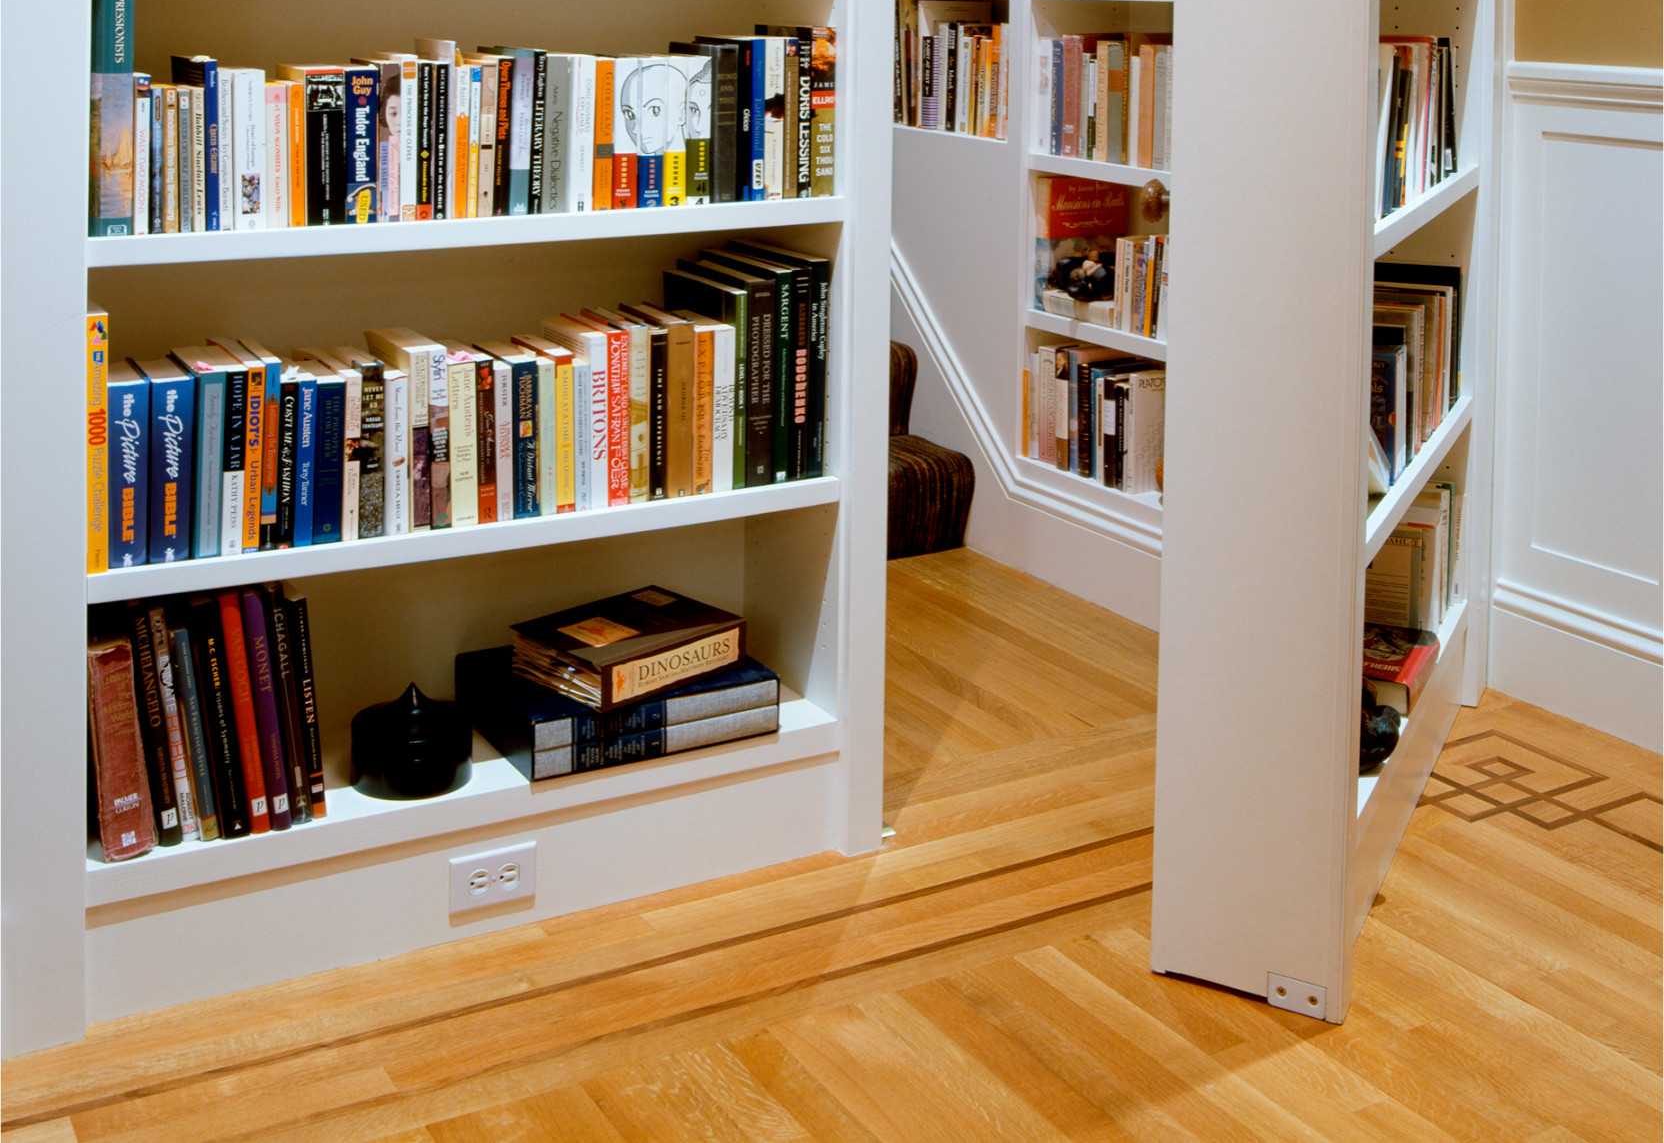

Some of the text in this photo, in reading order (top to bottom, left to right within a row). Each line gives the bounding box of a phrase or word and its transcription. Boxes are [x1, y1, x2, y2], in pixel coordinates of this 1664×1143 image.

[352, 76, 373, 85] John
[353, 86, 371, 96] Guy
[460, 71, 468, 86] Paul
[498, 62, 511, 139] Opera Themes Plots
[604, 72, 613, 137] GEORGIANA
[209, 124, 218, 145] Queen
[353, 106, 370, 181] Tudor England
[532, 100, 544, 196] LITERARY THEORY
[550, 112, 563, 209] Negative Dialectics
[799, 77, 810, 182] DORIS LESSING
[359, 196, 368, 221] USED
[819, 282, 827, 299] John
[463, 368, 473, 391] Jane
[751, 317, 760, 404] PHOTOGRAPHER
[762, 314, 771, 404] DRESSED FOR THE
[818, 336, 826, 360] Copley
[230, 375, 243, 468] HOPE IN JAR
[249, 395, 259, 446] IDIOT'S
[302, 388, 313, 447] Jane Austen
[452, 371, 460, 410] Letters
[592, 371, 606, 460] BRITONS
[610, 337, 620, 489] JONATHAN SAFRAN FOER
[89, 362, 106, 532] Amazing 1000 Puzzle Challenge
[115, 394, 140, 542] the Picture BIBLE
[159, 389, 183, 536] the Picture BIBLE
[281, 396, 295, 504] COSTUME FASHION
[230, 475, 238, 503] KATHY
[247, 460, 259, 540] Urban Legends
[301, 461, 310, 506] Tony Tanner
[135, 617, 161, 728] MICHELANGELO
[253, 637, 271, 692] MONET
[638, 638, 730, 680] DINOSAURS
[303, 678, 315, 724] LISTEN
[165, 714, 188, 781] ROBOT
